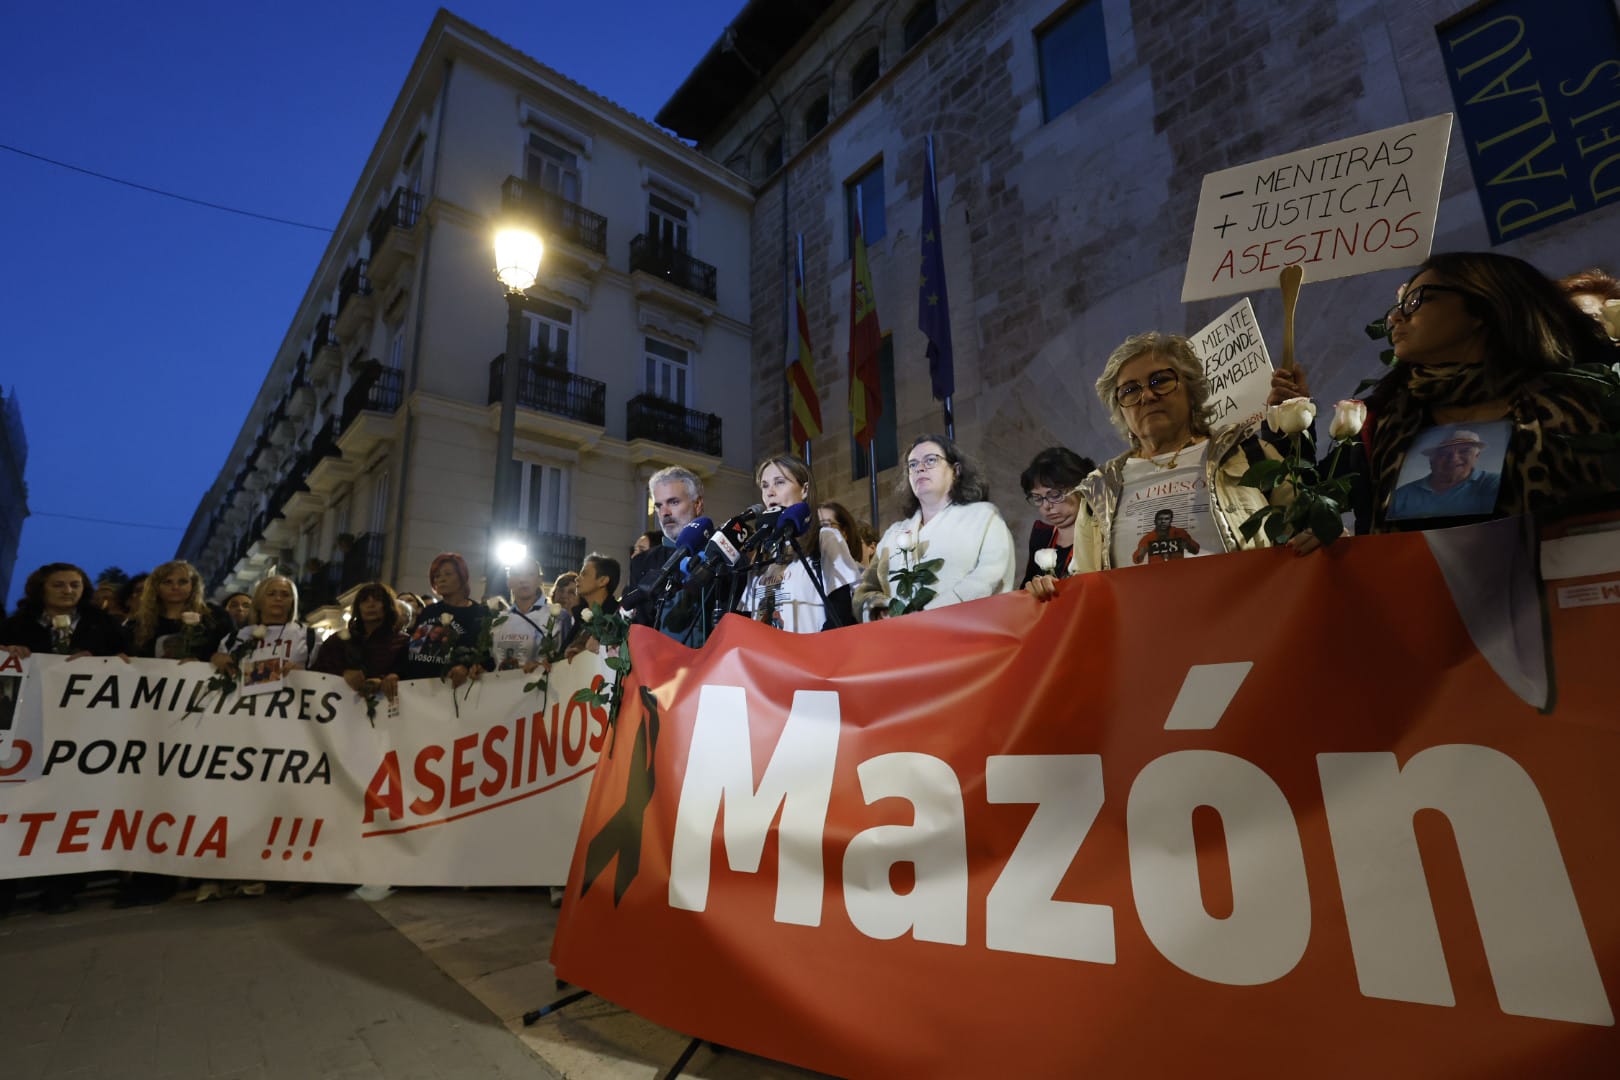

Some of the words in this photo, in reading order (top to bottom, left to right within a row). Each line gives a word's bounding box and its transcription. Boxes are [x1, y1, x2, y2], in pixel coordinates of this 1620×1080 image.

[1449, 15, 1576, 238] PALAU
[1255, 133, 1417, 195] MENTIRAS
[1247, 173, 1412, 232] JUSTICIA
[1211, 211, 1422, 282] ASESINOS
[1202, 306, 1252, 355] MIENTE
[1205, 327, 1259, 377] ESCONDE
[1151, 541, 1179, 554] 228
[59, 674, 342, 724] FAMILIARES
[42, 740, 147, 776] POR
[158, 741, 332, 785] VUESTRA
[362, 674, 608, 824] ASESINOS
[0, 809, 228, 859] TENCIA
[668, 661, 1615, 1027] Mazón
